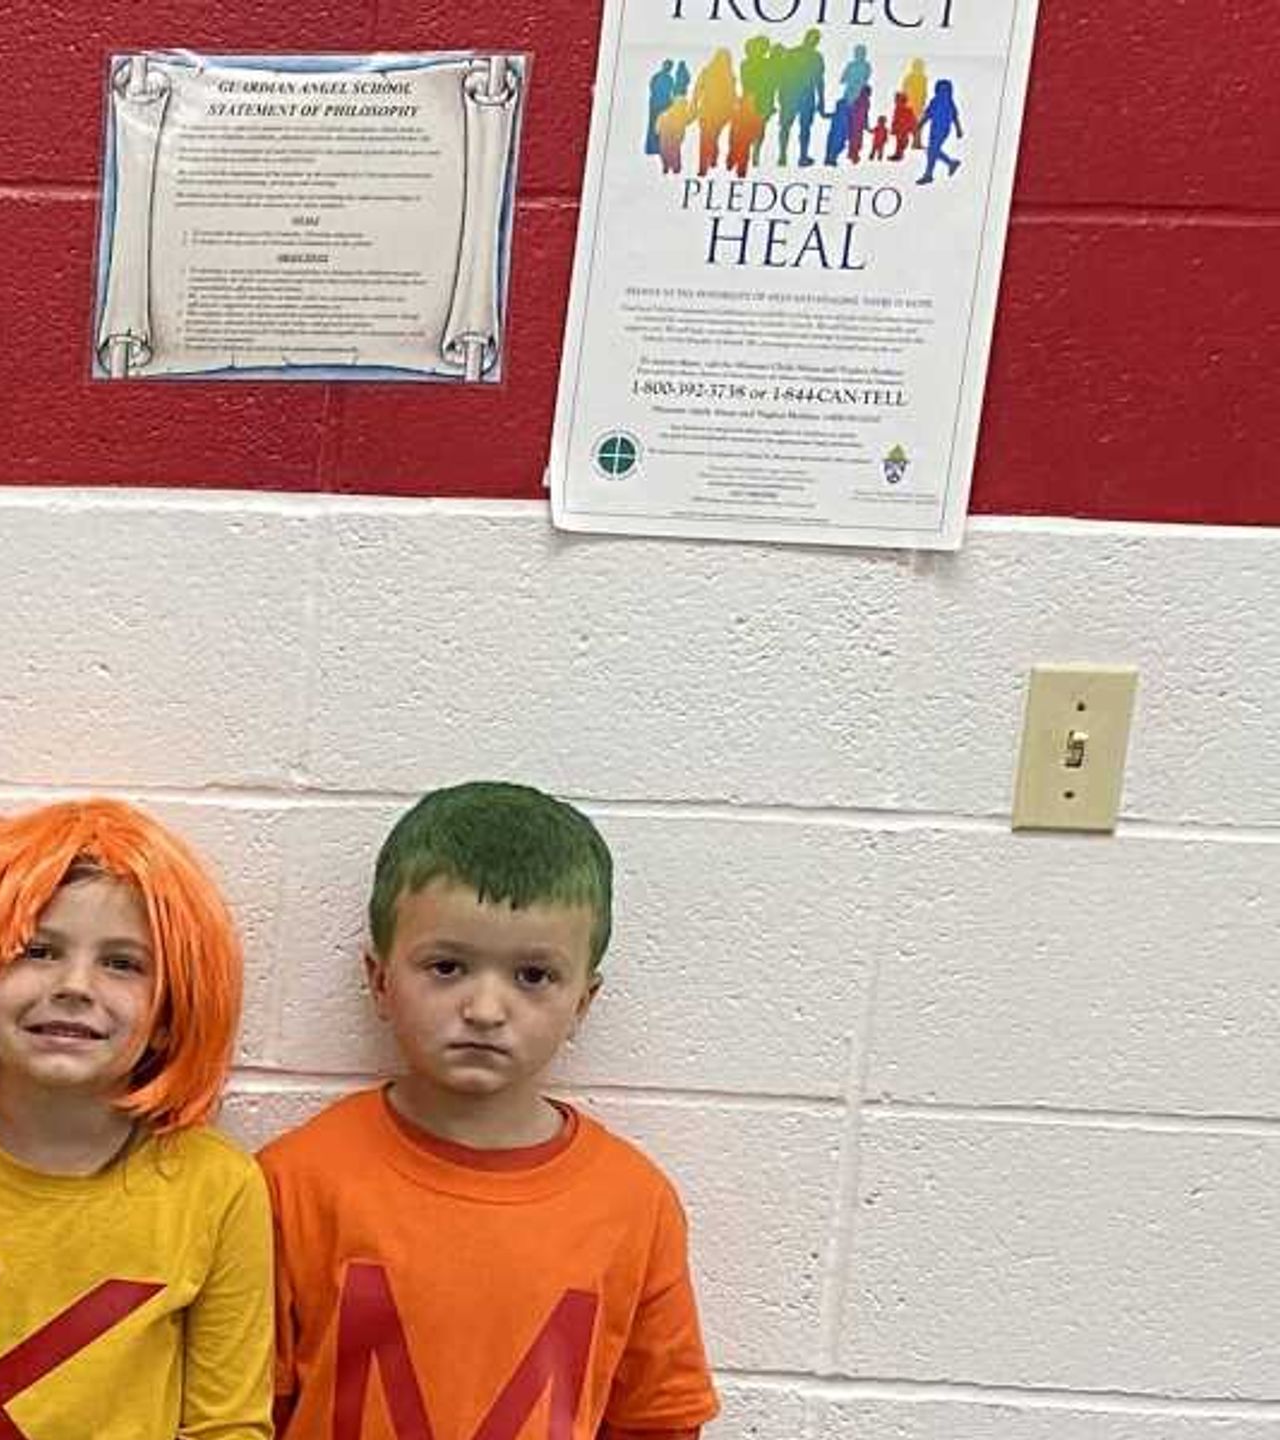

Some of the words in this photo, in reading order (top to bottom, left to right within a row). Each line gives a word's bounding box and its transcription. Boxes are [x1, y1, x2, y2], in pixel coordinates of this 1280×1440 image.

[217, 80, 295, 95] GUARDIAN
[297, 81, 350, 96] ANGEL
[351, 80, 414, 96] SCHOOL
[207, 102, 297, 117] STATEMENT
[299, 103, 321, 117] OF
[323, 103, 421, 118] PHILOSOPHY
[681, 178, 833, 215] PLEDGE
[849, 185, 903, 218] TO
[705, 216, 868, 271] HEAL
